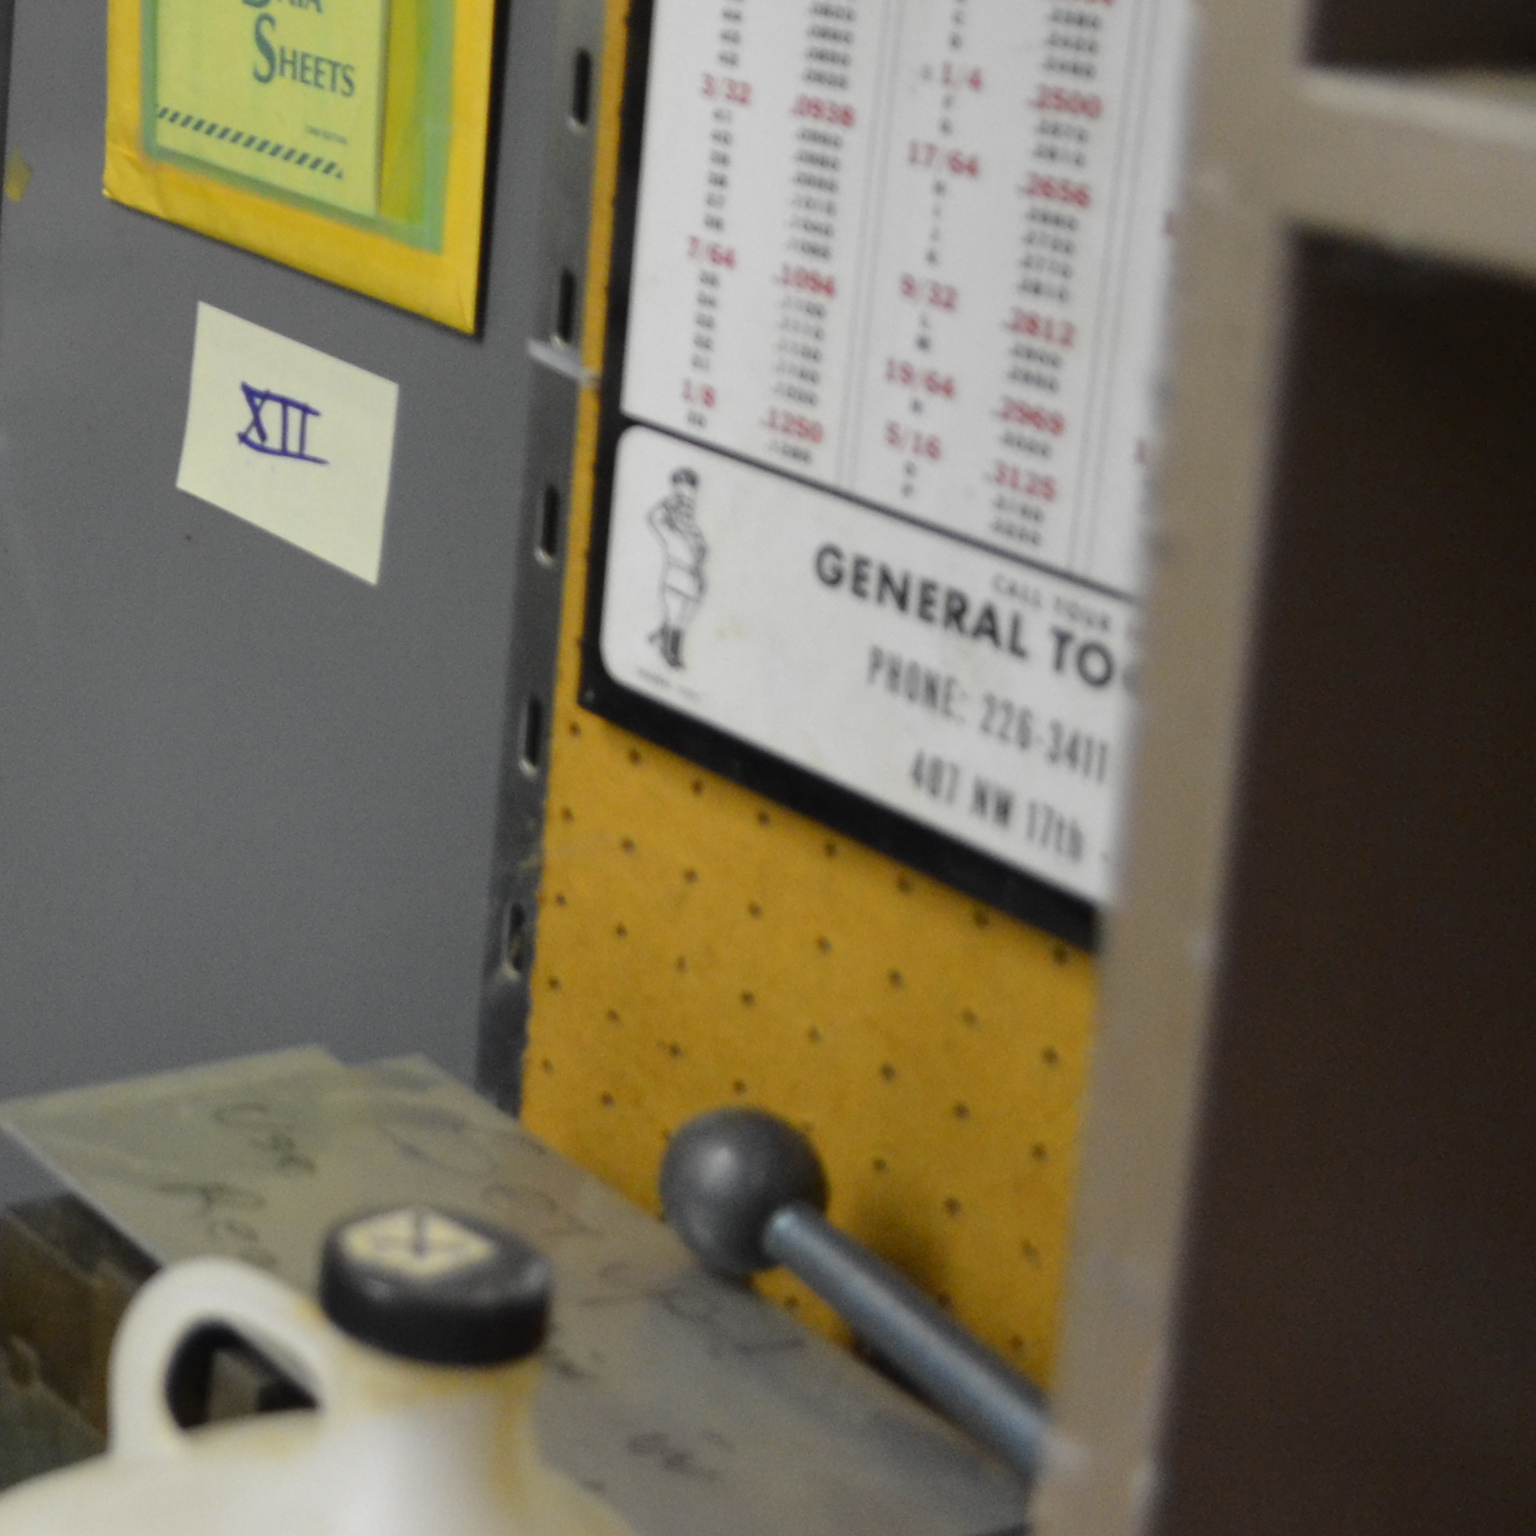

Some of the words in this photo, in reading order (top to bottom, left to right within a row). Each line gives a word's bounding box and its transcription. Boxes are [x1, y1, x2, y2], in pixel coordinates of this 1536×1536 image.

[237, 380, 331, 466] XII
[814, 542, 1029, 661] GENERAL
[1048, 624, 1128, 689] TO
